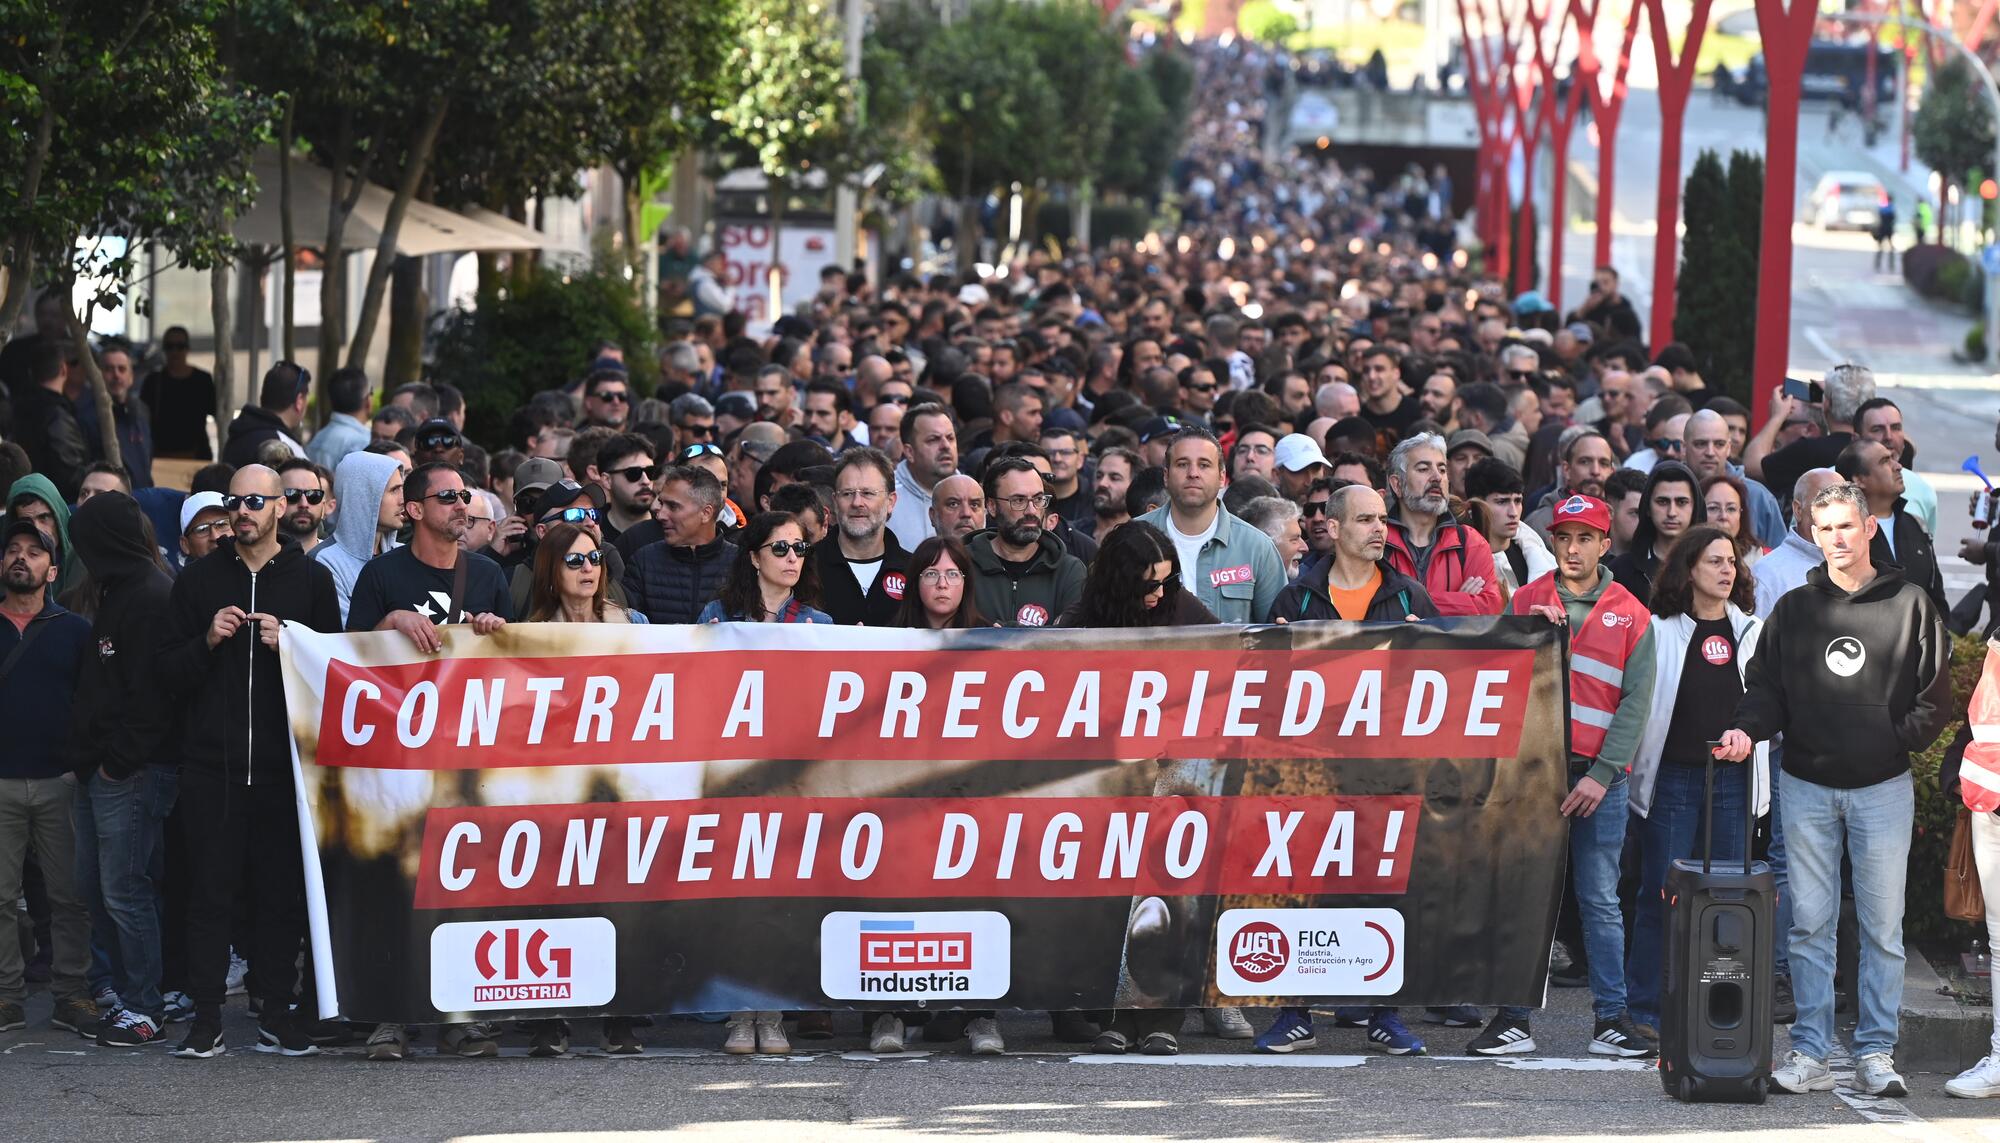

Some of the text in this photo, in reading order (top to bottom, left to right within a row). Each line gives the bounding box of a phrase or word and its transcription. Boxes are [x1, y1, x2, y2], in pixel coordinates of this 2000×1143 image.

[1210, 569, 1237, 585] UGT
[1705, 641, 1729, 655] CIG
[341, 669, 1510, 748] CONTRA A PRECARIEDADE
[439, 810, 1405, 892] CONVENIO DIGNO XA!
[1236, 931, 1283, 956] UGT
[1298, 930, 1340, 947] FICA
[474, 928, 572, 981] CIG
[867, 940, 965, 963] CCOO
[1298, 949, 1333, 958] Industria,
[1298, 956, 1374, 966] Construcción y Agro
[1298, 965, 1327, 975] Galicia
[860, 972, 970, 993] industria
[476, 984, 570, 1001] INDUSTRIA
